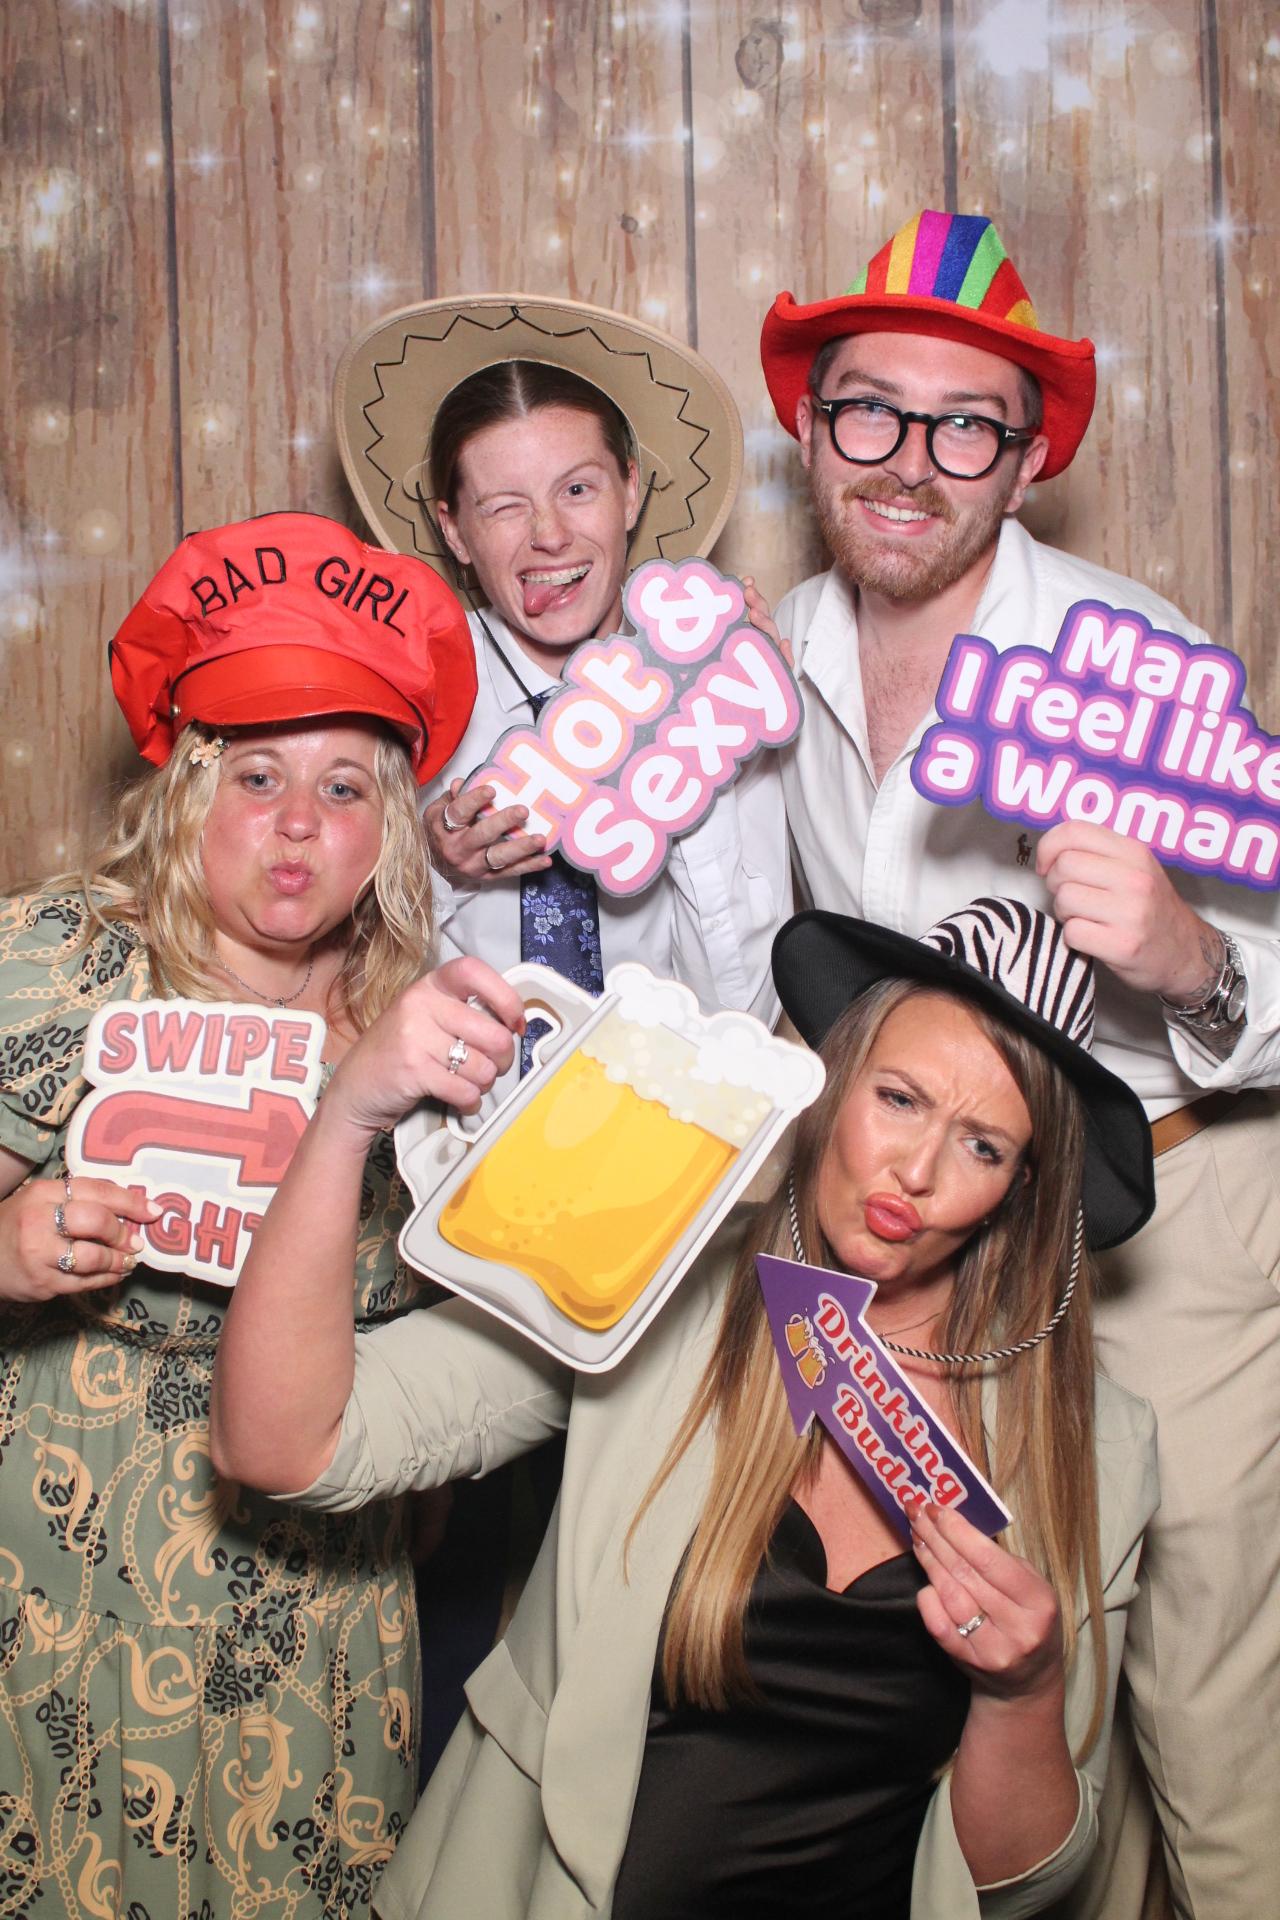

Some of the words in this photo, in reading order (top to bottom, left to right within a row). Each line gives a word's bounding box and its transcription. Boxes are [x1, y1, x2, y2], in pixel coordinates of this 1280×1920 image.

[190, 546, 287, 618] BAD
[314, 556, 411, 638] GIRL
[488, 652, 662, 836] Hot
[640, 575, 733, 653] &
[951, 652, 982, 712] I
[993, 661, 1155, 759] feel
[1065, 615, 1231, 713] Man
[573, 640, 788, 882] Sexy
[926, 739, 975, 790] a
[997, 745, 1279, 876] Woman
[98, 1010, 312, 1084] SWIPE
[817, 1298, 963, 1505] Drinking
[836, 1388, 927, 1505] Budd
